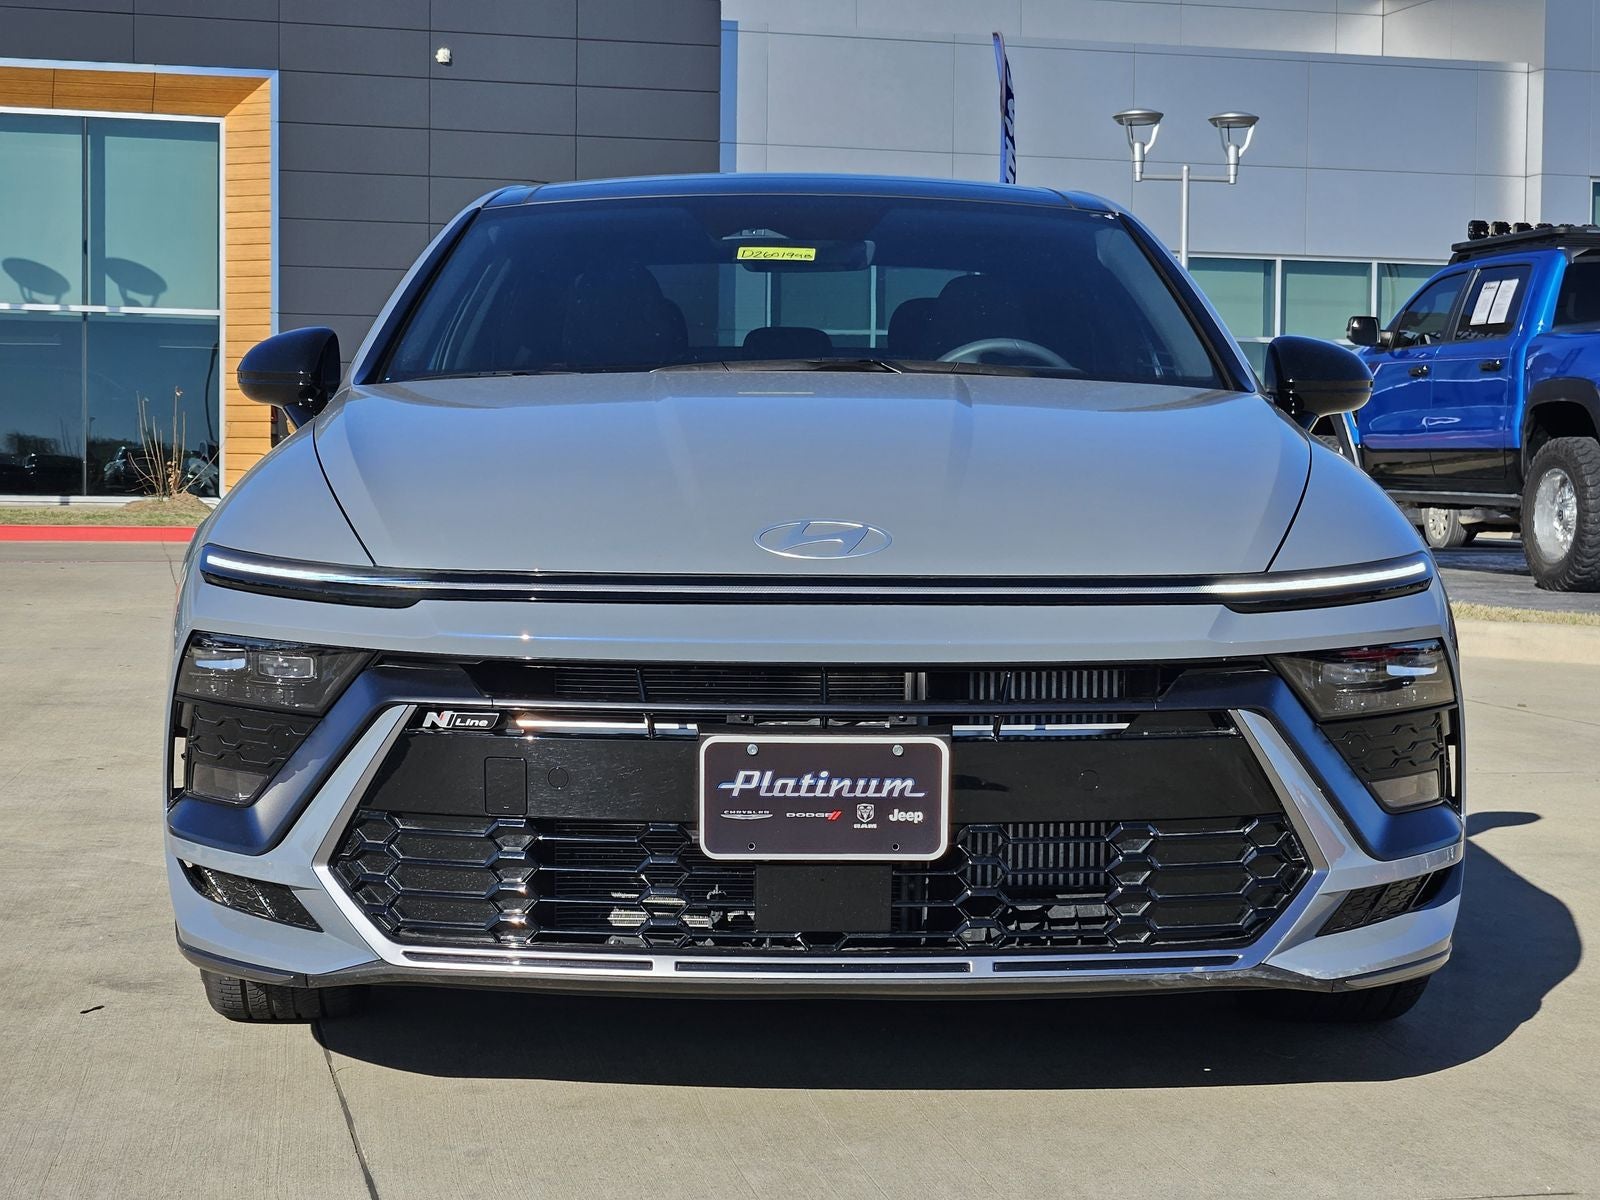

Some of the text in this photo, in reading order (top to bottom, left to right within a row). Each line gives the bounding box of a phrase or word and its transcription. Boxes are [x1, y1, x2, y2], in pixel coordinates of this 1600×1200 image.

[455, 718, 489, 727] Line
[718, 770, 925, 798] Platinum
[888, 808, 924, 824] Jeep
